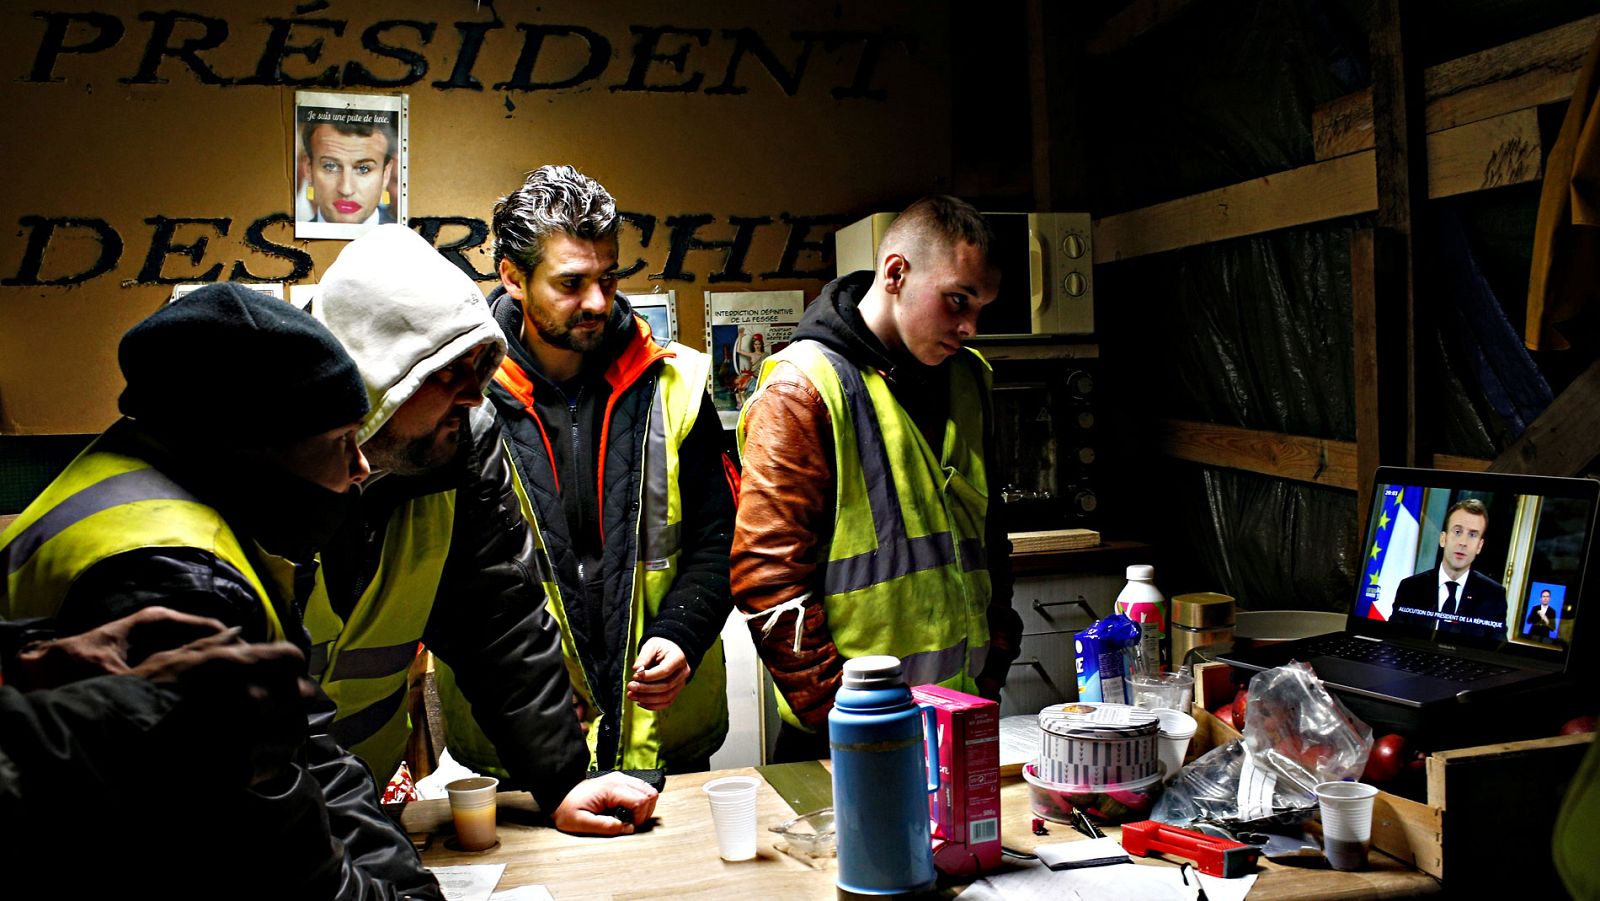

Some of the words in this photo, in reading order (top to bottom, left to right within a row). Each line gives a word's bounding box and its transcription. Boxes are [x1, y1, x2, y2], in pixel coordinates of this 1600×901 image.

[14, 0, 918, 98] PRÉSIDENT
[307, 110, 316, 121] Je
[317, 111, 331, 120] suis
[332, 114, 346, 122] une
[346, 113, 362, 124] pute
[363, 114, 373, 123] de
[0, 212, 314, 288] DES
[1398, 606, 1427, 616] ALLOCUTION
[1434, 611, 1458, 620] PRÉSIDENT
[1473, 617, 1503, 628] RÉPUBLIQUE
